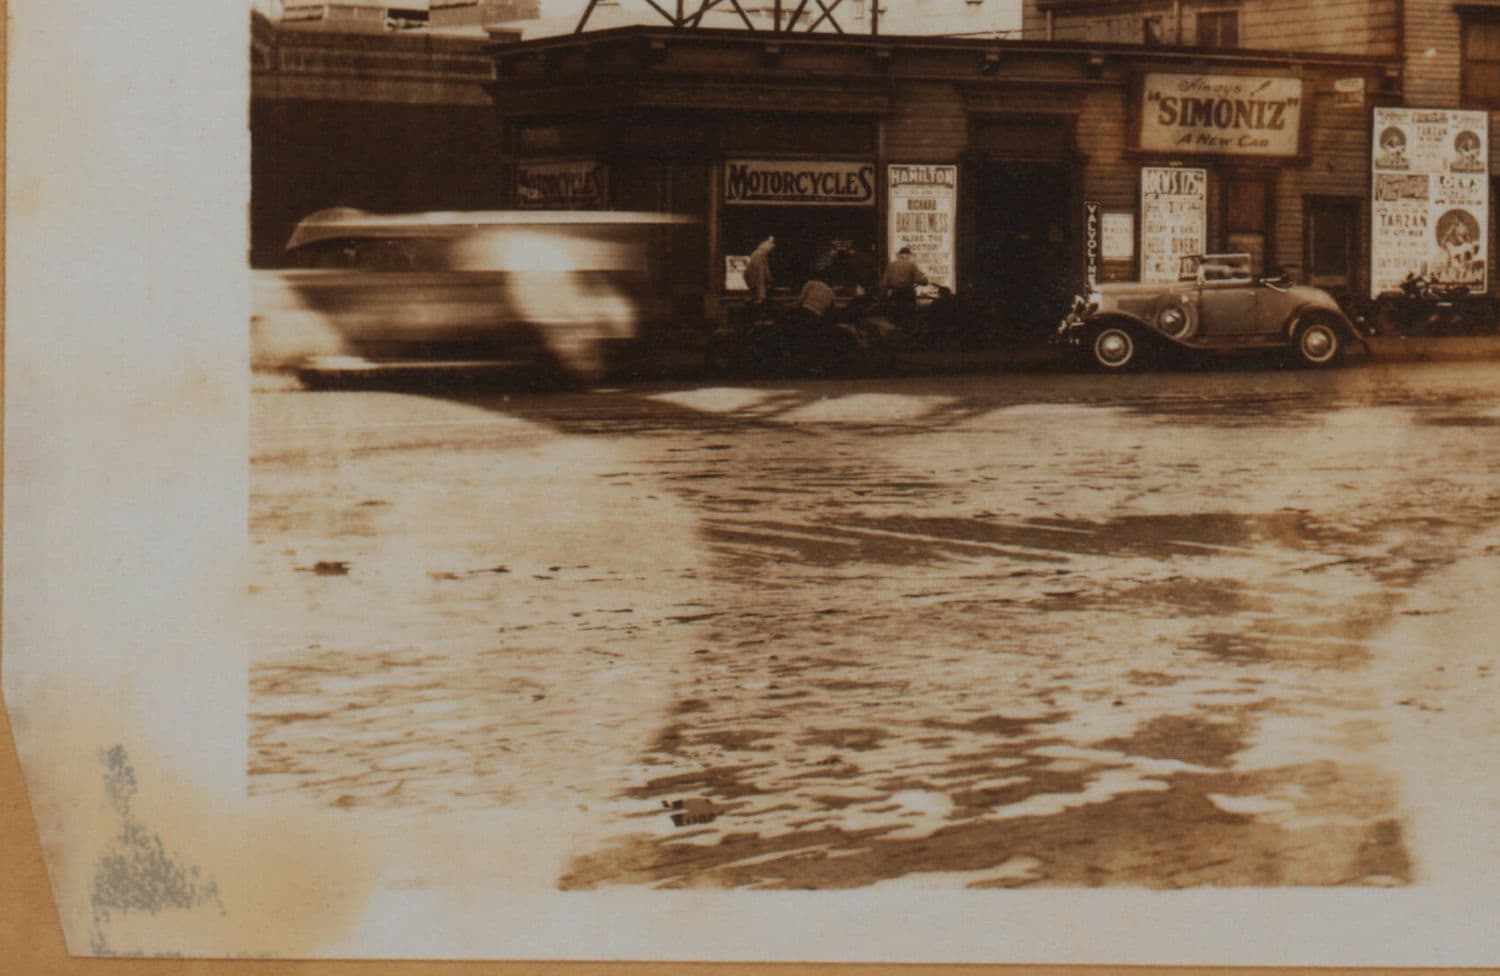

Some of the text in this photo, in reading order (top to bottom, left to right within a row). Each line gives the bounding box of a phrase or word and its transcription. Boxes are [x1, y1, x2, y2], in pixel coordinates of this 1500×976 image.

[1178, 78, 1242, 96] Always
[1176, 133, 1192, 145] A
[726, 163, 874, 201] MOTORCYCLES
[890, 167, 954, 185] HAMILTON
[1380, 214, 1427, 228] TARZAN
